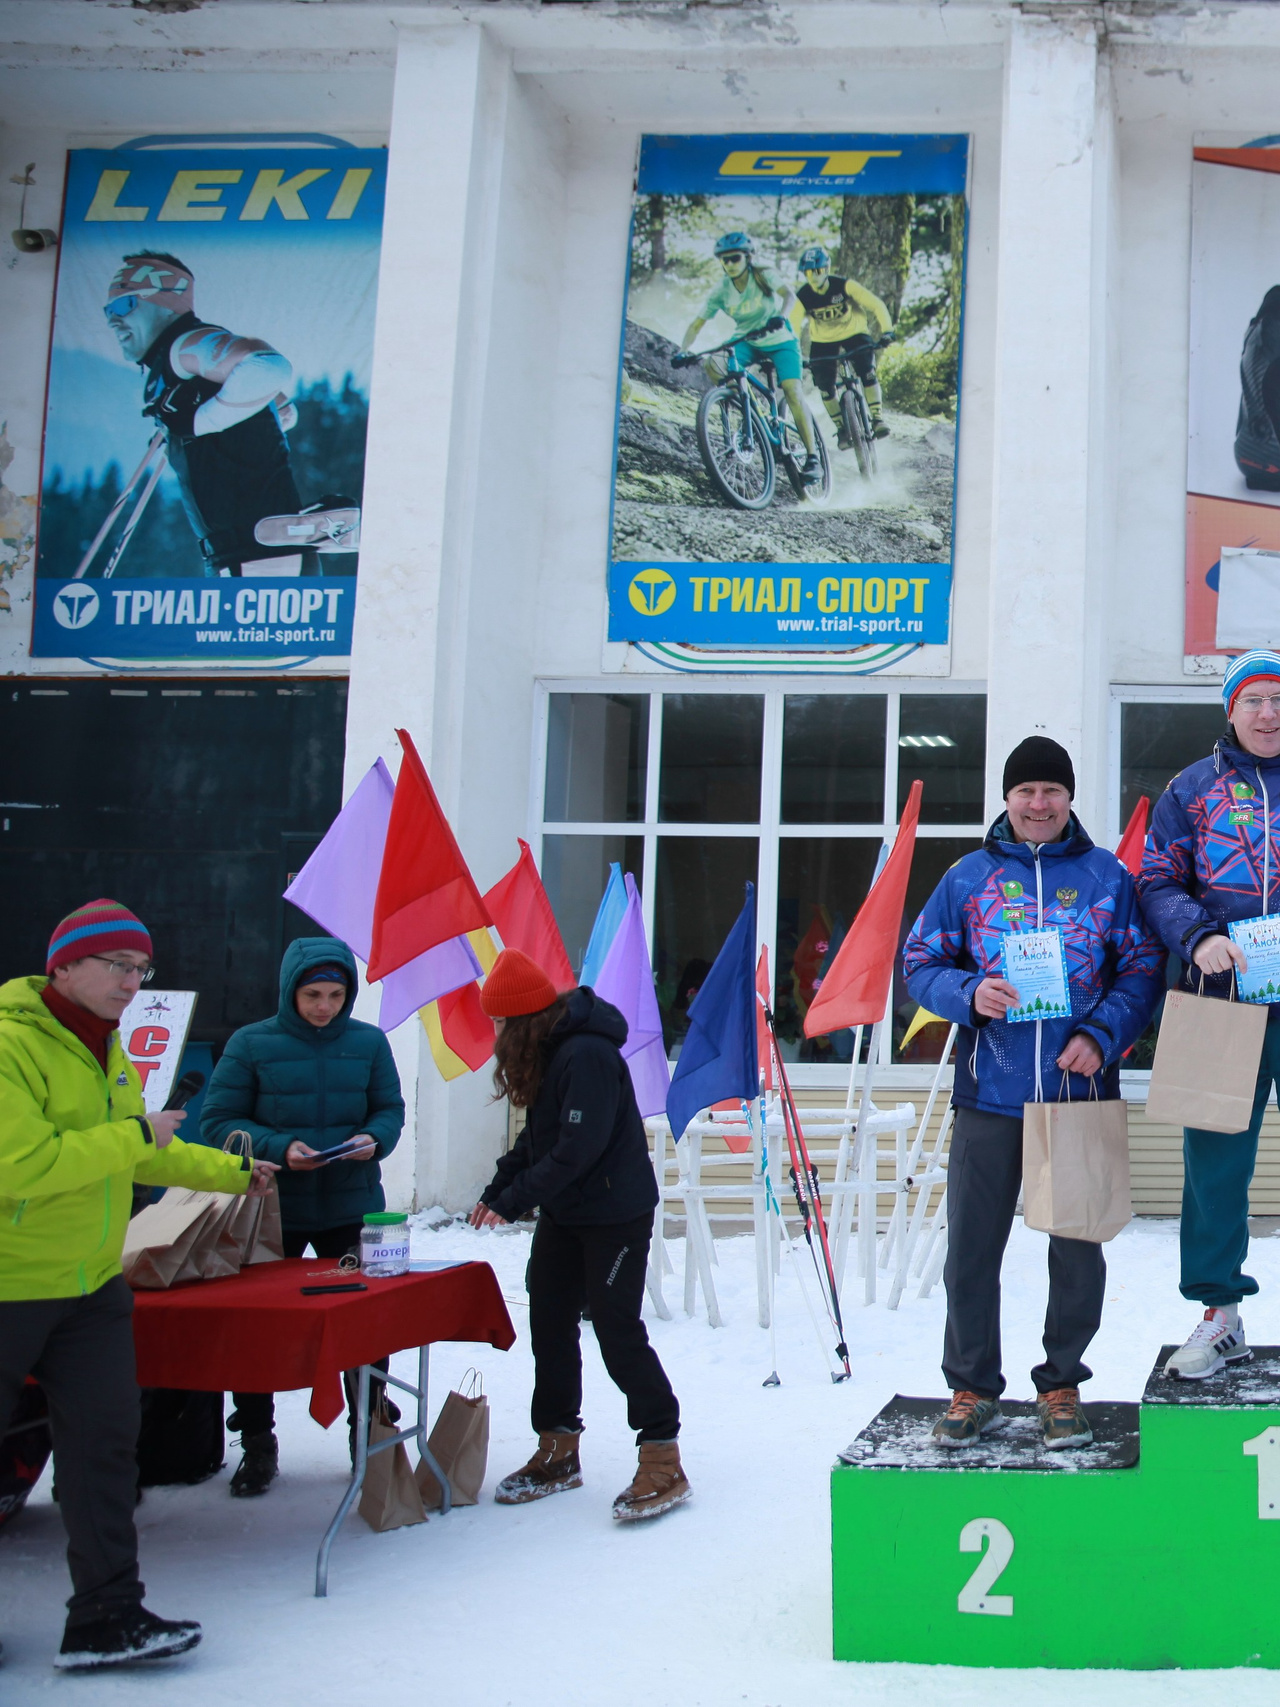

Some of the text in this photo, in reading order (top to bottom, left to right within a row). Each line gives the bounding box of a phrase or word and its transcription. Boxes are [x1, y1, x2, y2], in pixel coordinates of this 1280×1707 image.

[719, 150, 902, 176] GT
[781, 177, 855, 186] BICYCLES
[84, 168, 373, 222] LEKI
[196, 627, 336, 645] www.trial-sport.ru
[777, 617, 923, 635] www.trial-sport.ru
[1012, 950, 1055, 963] ГРАМОТА
[606, 1246, 630, 1287] noname
[957, 1517, 1015, 1617] 2
